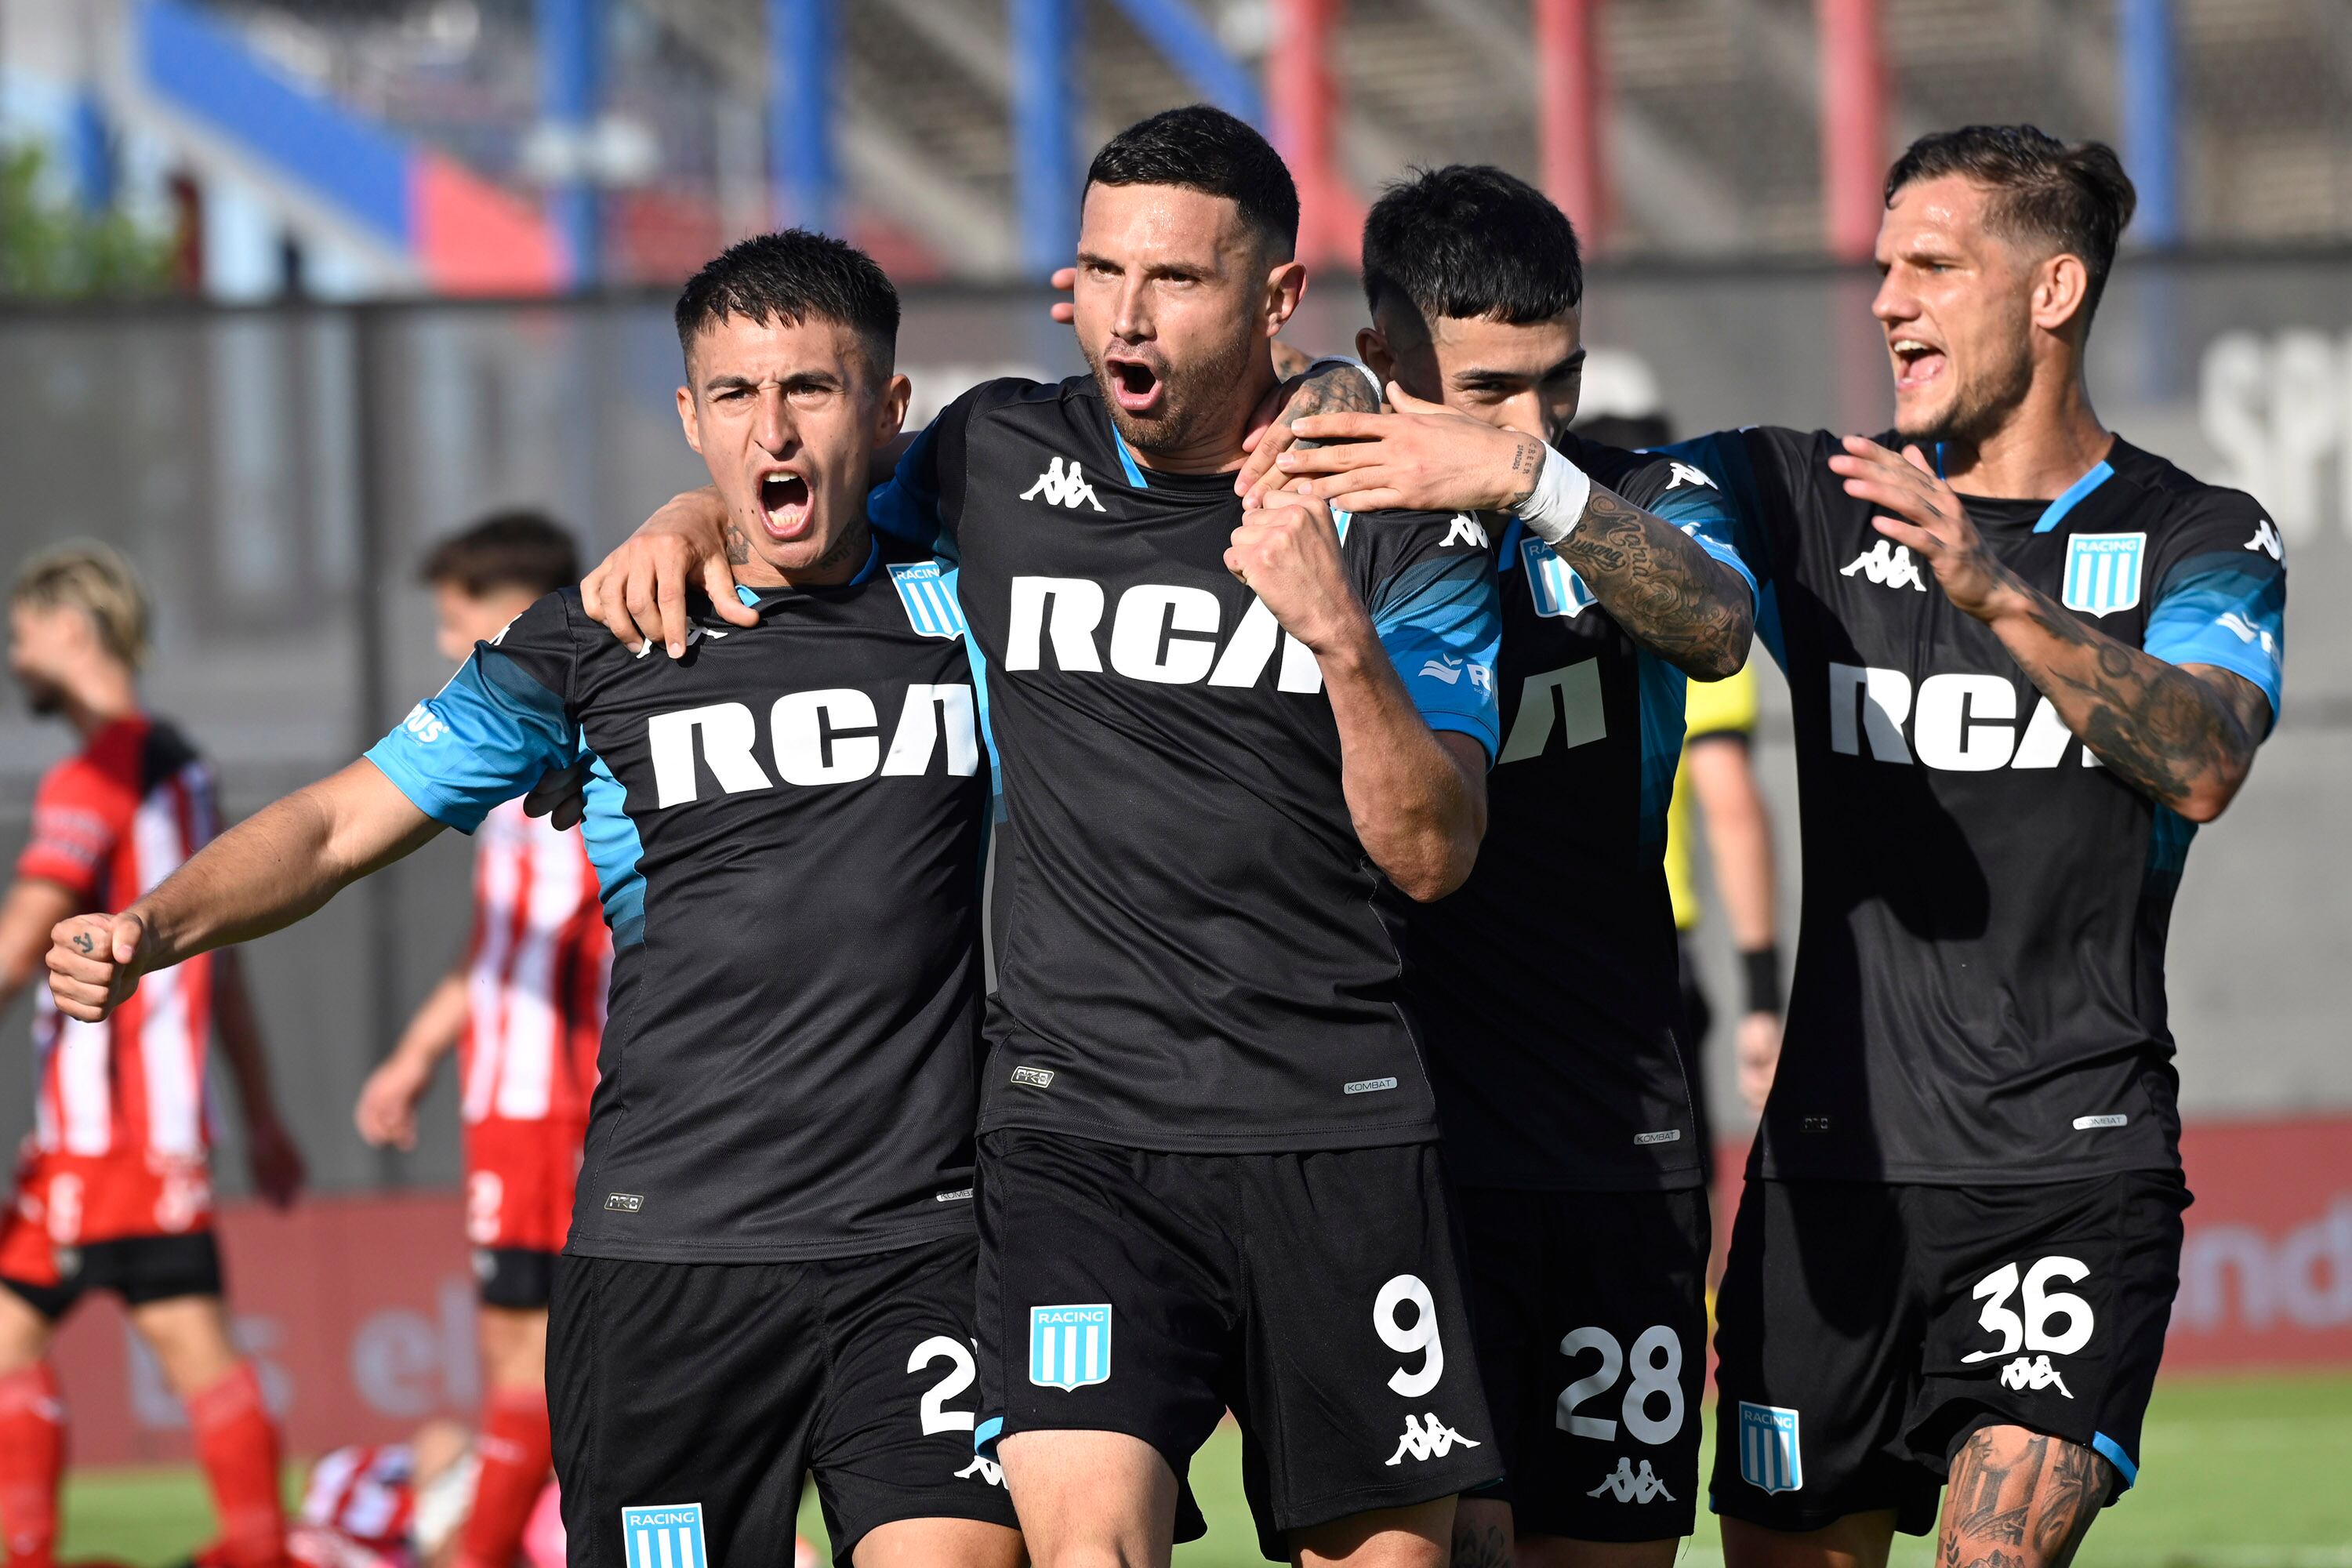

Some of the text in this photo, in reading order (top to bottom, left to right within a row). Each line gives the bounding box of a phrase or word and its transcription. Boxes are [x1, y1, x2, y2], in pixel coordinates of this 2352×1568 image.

[2075, 539, 2137, 553] RACING
[895, 568, 940, 580] RACIN
[648, 684, 979, 809] RCA
[1016, 1069, 1048, 1084] PRO
[1348, 1080, 1391, 1091] KOMBAT
[1637, 1132, 1675, 1142] KOMBAT
[941, 1190, 973, 1200] KOMB
[609, 1196, 639, 1210] PRO
[1960, 1256, 2094, 1363] 36
[1038, 1311, 1105, 1324] RACING
[1373, 1274, 1443, 1397] 9
[906, 1336, 978, 1436] 2
[1555, 1325, 1685, 1445] 28
[1744, 1410, 1793, 1430] RACING
[630, 1512, 695, 1526] RACING
